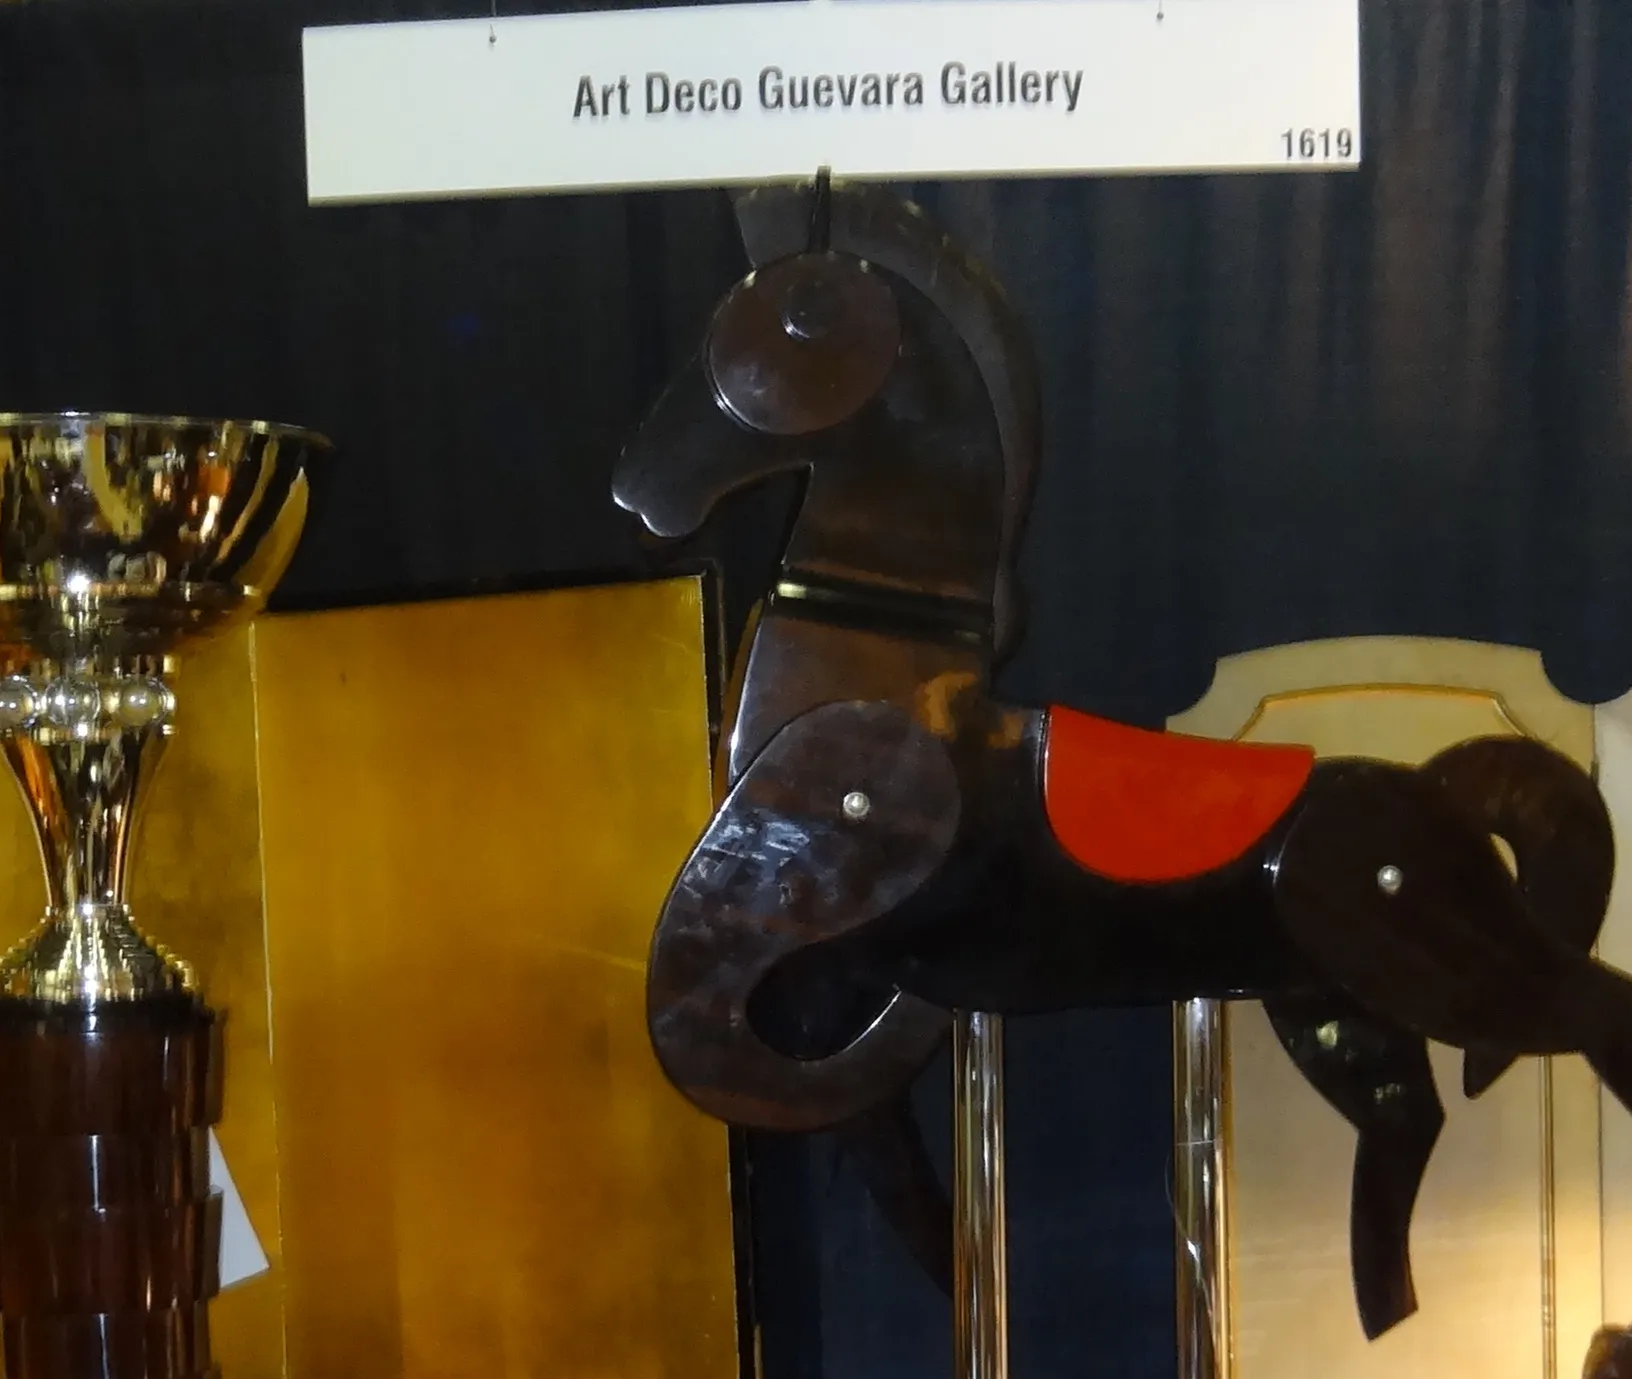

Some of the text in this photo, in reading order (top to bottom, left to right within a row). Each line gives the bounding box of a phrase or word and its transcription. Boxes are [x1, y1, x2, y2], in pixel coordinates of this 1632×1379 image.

[572, 61, 1084, 118] Art Deco Guevara Gallery
[1281, 127, 1352, 158] 1619
